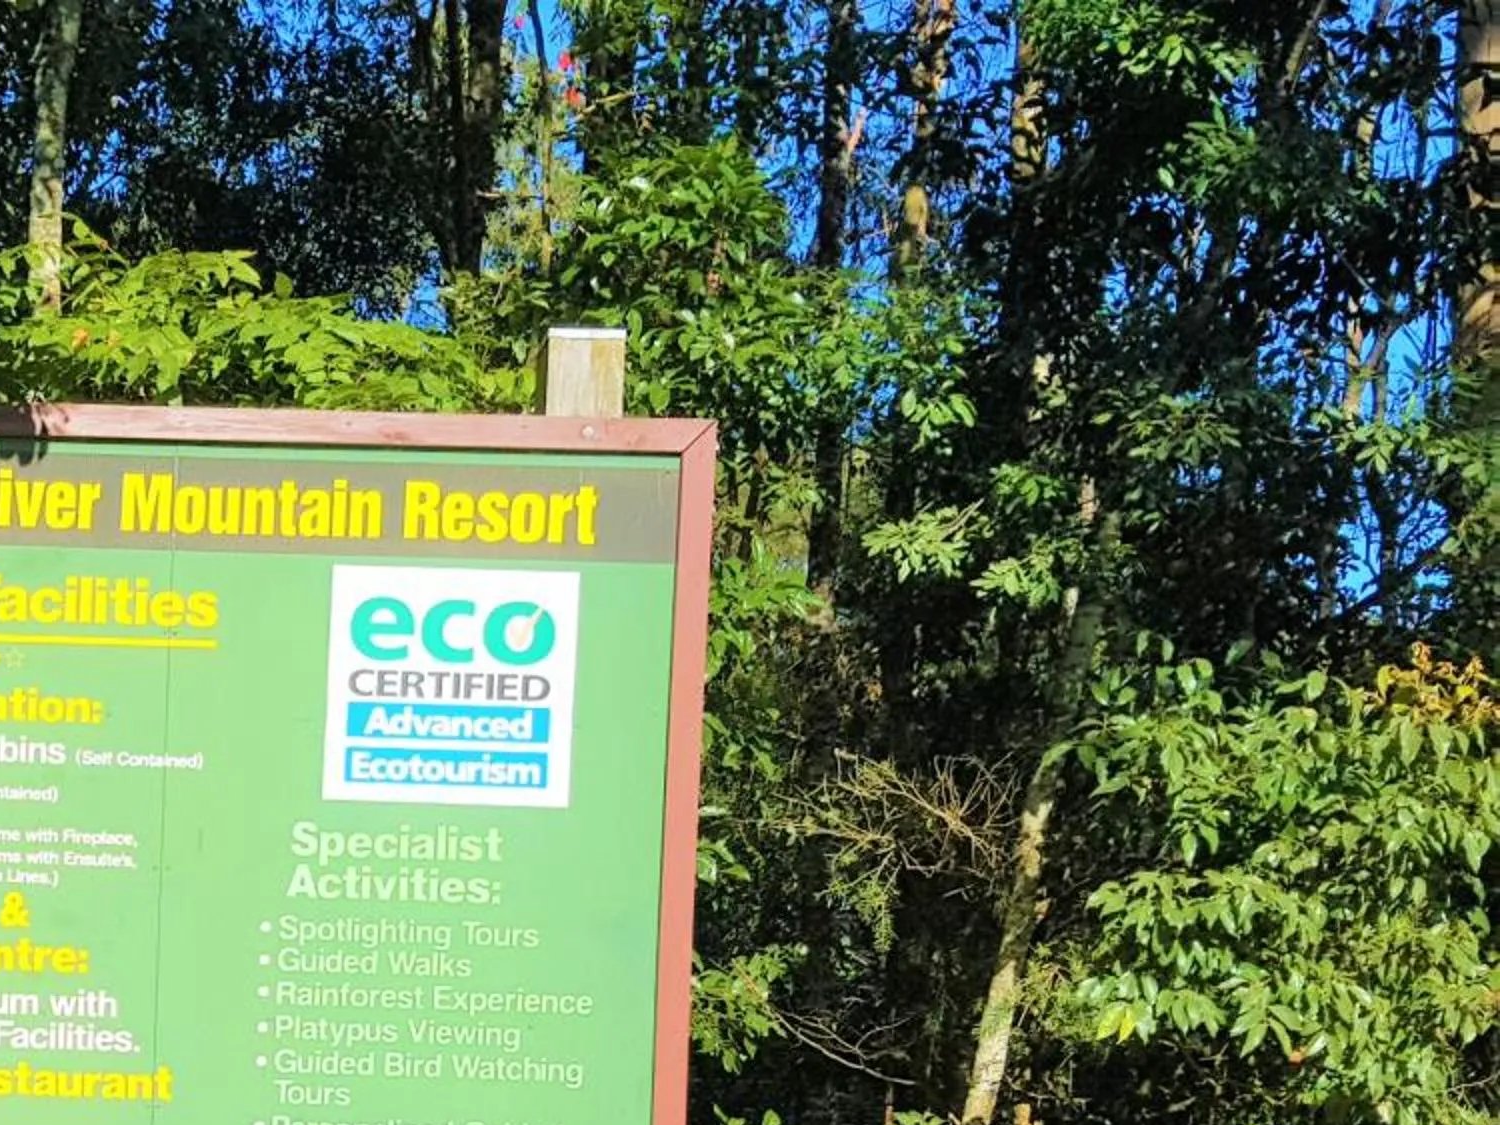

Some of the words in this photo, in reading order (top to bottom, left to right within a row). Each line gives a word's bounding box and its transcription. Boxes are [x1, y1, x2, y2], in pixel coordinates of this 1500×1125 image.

[120, 472, 382, 540] Mountain
[403, 480, 597, 546] Resort
[350, 597, 556, 665] eco
[348, 668, 550, 701] CERTIFIED
[363, 706, 533, 741] Advanced
[75, 749, 113, 767] (Self
[116, 751, 204, 770] Contained)
[351, 751, 541, 787] Ecotourism
[25, 828, 58, 843] with
[291, 821, 503, 864] Specialist
[26, 851, 59, 865] with
[287, 865, 501, 904] Activities:
[0, 891, 30, 927] &
[278, 916, 452, 949] Spotlighting
[462, 921, 539, 947] Tours
[277, 949, 378, 975] Guided
[389, 952, 472, 977] Walks
[50, 989, 118, 1018] with
[275, 982, 423, 1010] Rainforest
[434, 985, 592, 1016] Experience
[274, 1016, 398, 1045] Platypus
[408, 1019, 521, 1052] Viewing
[274, 1050, 375, 1076] Guided
[384, 1052, 441, 1078] Bird
[452, 1055, 583, 1087] Watching
[275, 1080, 351, 1106] Tours
